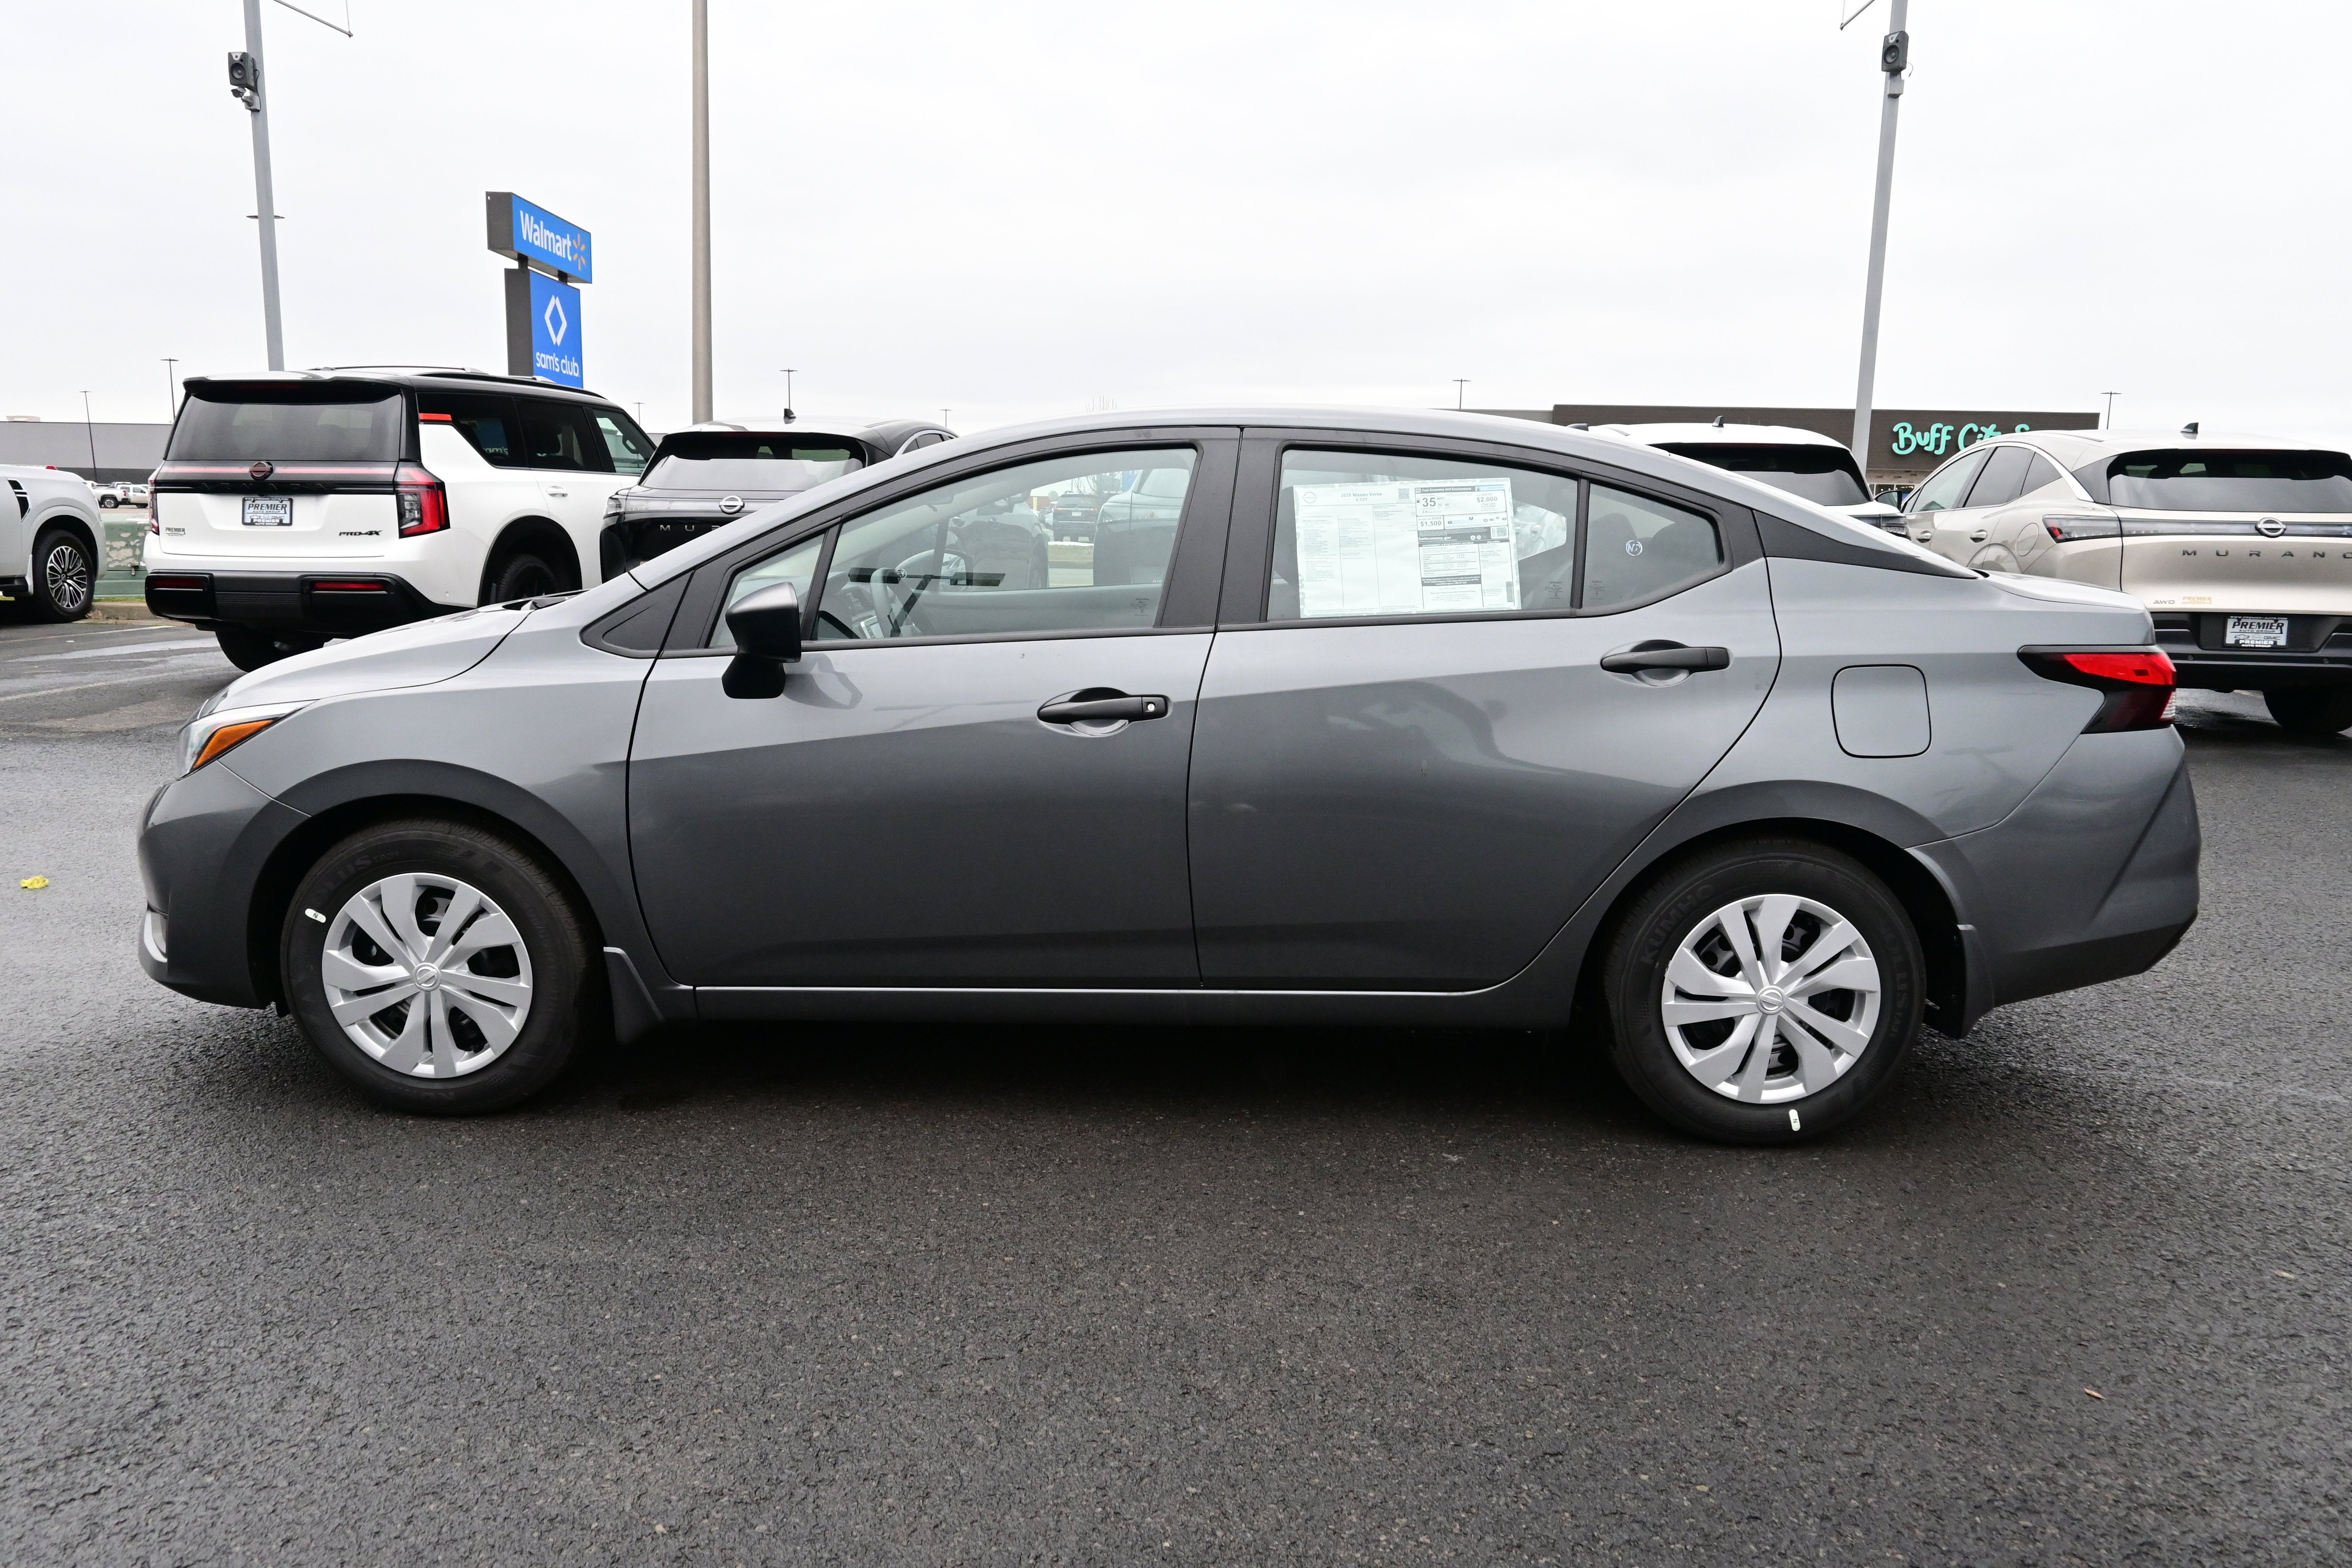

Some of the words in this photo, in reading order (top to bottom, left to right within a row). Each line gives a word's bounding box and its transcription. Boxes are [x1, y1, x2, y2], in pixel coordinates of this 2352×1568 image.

[520, 210, 572, 261] Walmart
[536, 352, 560, 372] sam's
[561, 357, 579, 377] club
[1892, 422, 1955, 455] Buff
[1957, 423, 2002, 452] Cit
[482, 446, 509, 455] am's
[248, 504, 287, 512] PREMIER
[1422, 498, 1436, 507] 35
[2232, 621, 2284, 631] PREMIER
[1640, 884, 1714, 965] KUMHO
